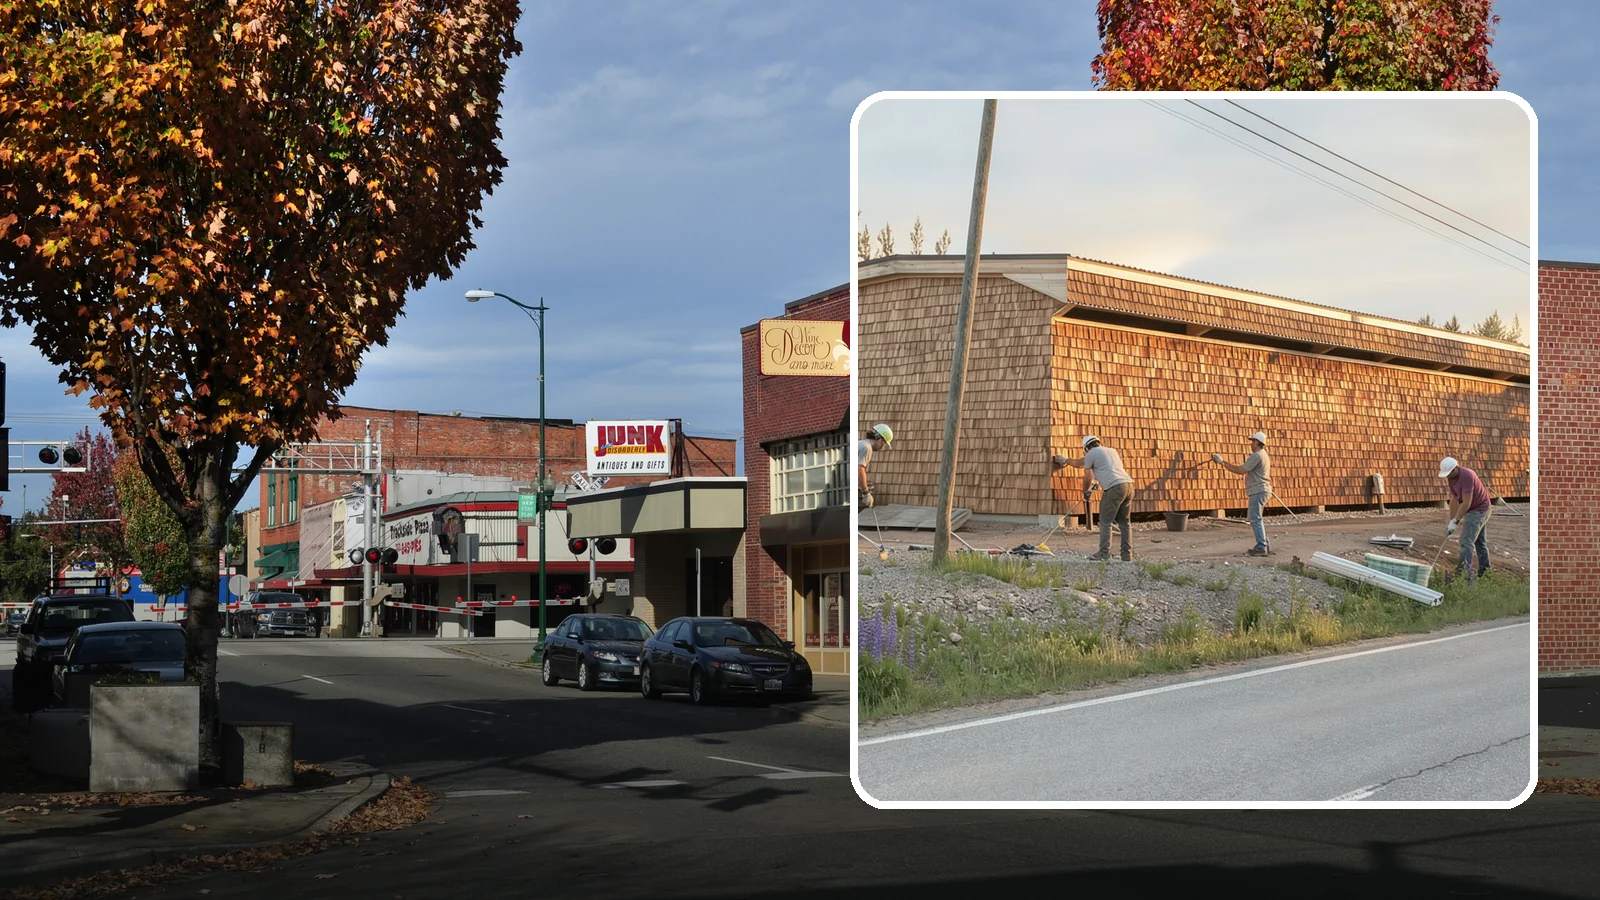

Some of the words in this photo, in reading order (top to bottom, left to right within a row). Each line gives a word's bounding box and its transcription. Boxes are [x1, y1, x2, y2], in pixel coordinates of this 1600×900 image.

[596, 425, 665, 458] JUNK
[607, 446, 646, 454] DISORDERLY
[596, 461, 628, 470] ANTIQUES
[631, 460, 644, 470] AND
[647, 460, 666, 470] GIFTS
[352, 498, 365, 511] CRO
[390, 521, 413, 540] Trackside
[414, 519, 429, 535] Pizza
